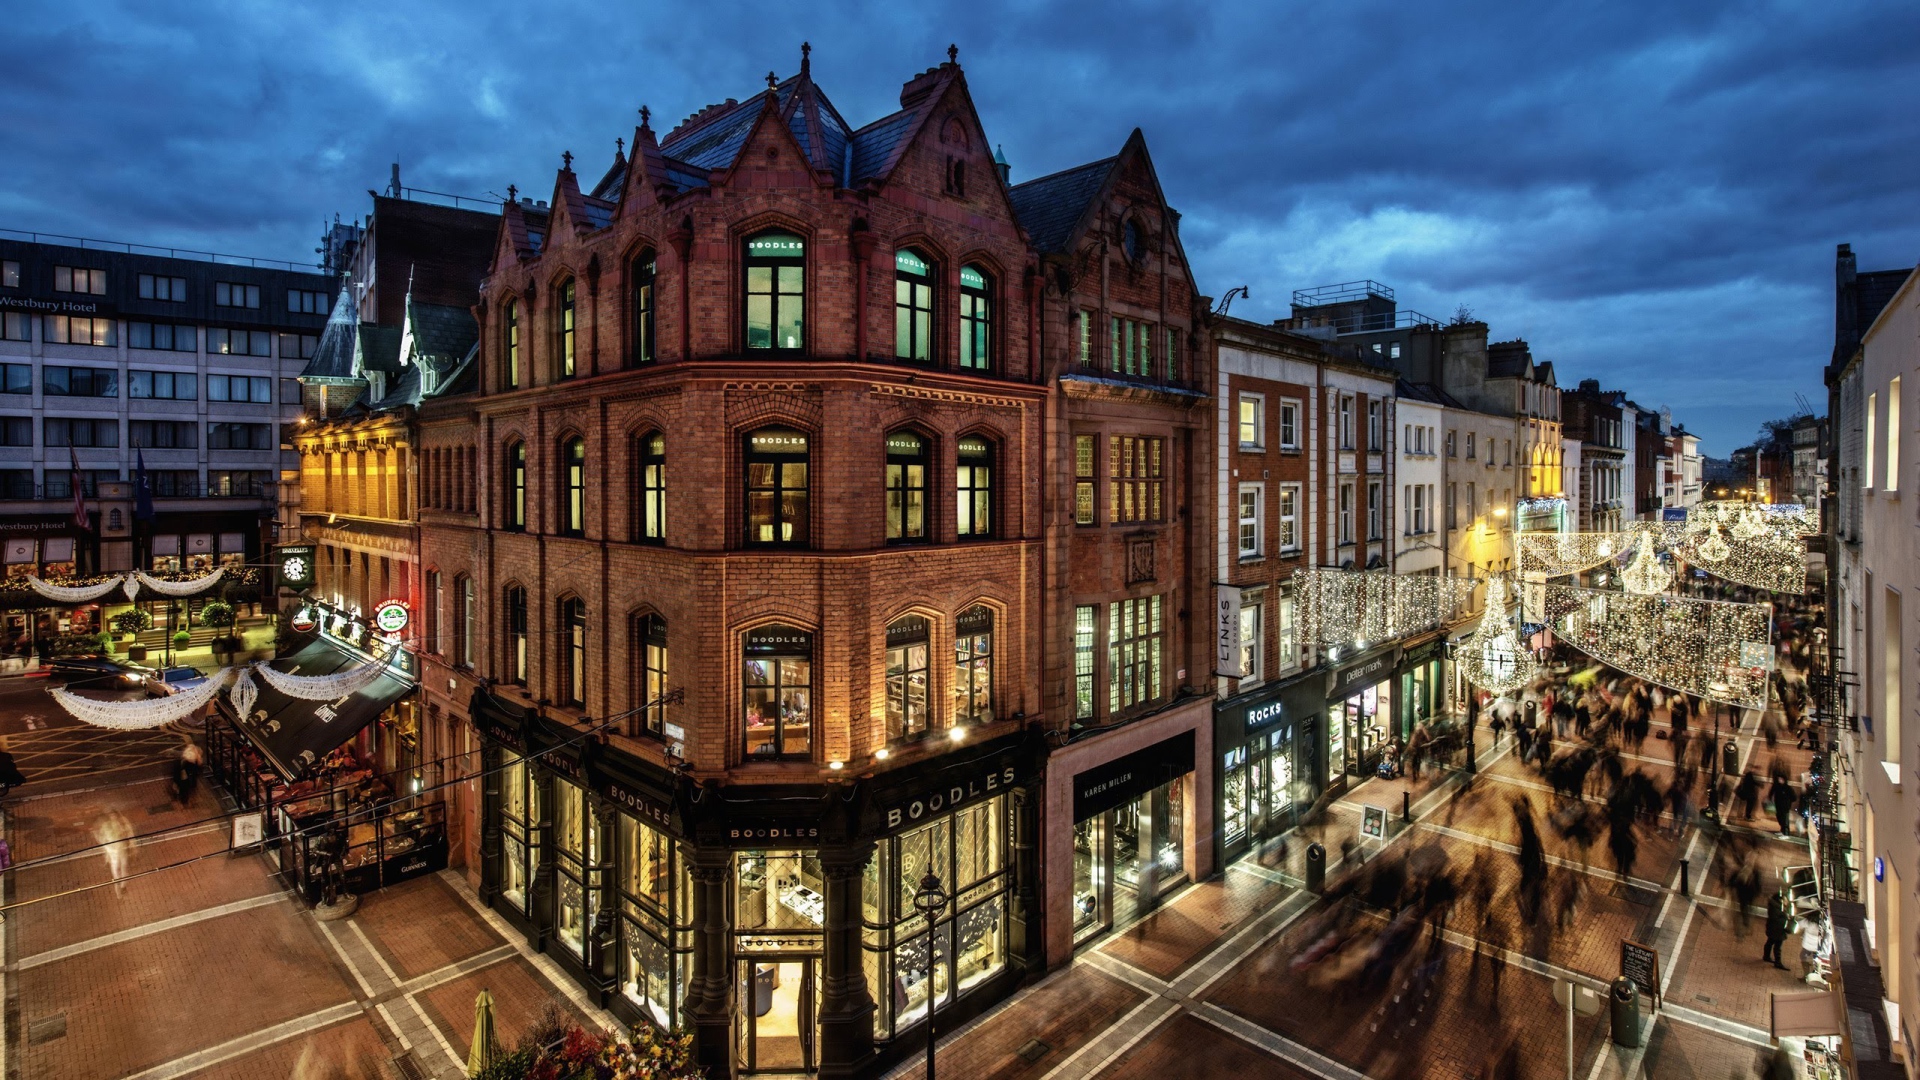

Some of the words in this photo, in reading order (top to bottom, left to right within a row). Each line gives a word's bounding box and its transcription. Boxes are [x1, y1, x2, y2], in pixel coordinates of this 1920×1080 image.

[961, 273, 988, 284] OODLES
[0, 297, 60, 312] Westbury
[63, 301, 97, 313] Hotel
[374, 599, 411, 613] BRUXELLES
[1221, 600, 1230, 661] LINKS
[1346, 666, 1365, 685] peter
[1365, 657, 1382, 674] mark
[1249, 702, 1281, 725] ROCKS
[542, 752, 580, 778] BOODLE
[1084, 782, 1107, 798] KAREN
[1108, 772, 1132, 788] MILLEN
[611, 785, 671, 826] BOODLES
[887, 767, 1014, 829] BOODLES
[731, 828, 818, 838] BOODLES
[401, 860, 428, 873] GUINNESS
[745, 939, 815, 947] BOODLES
